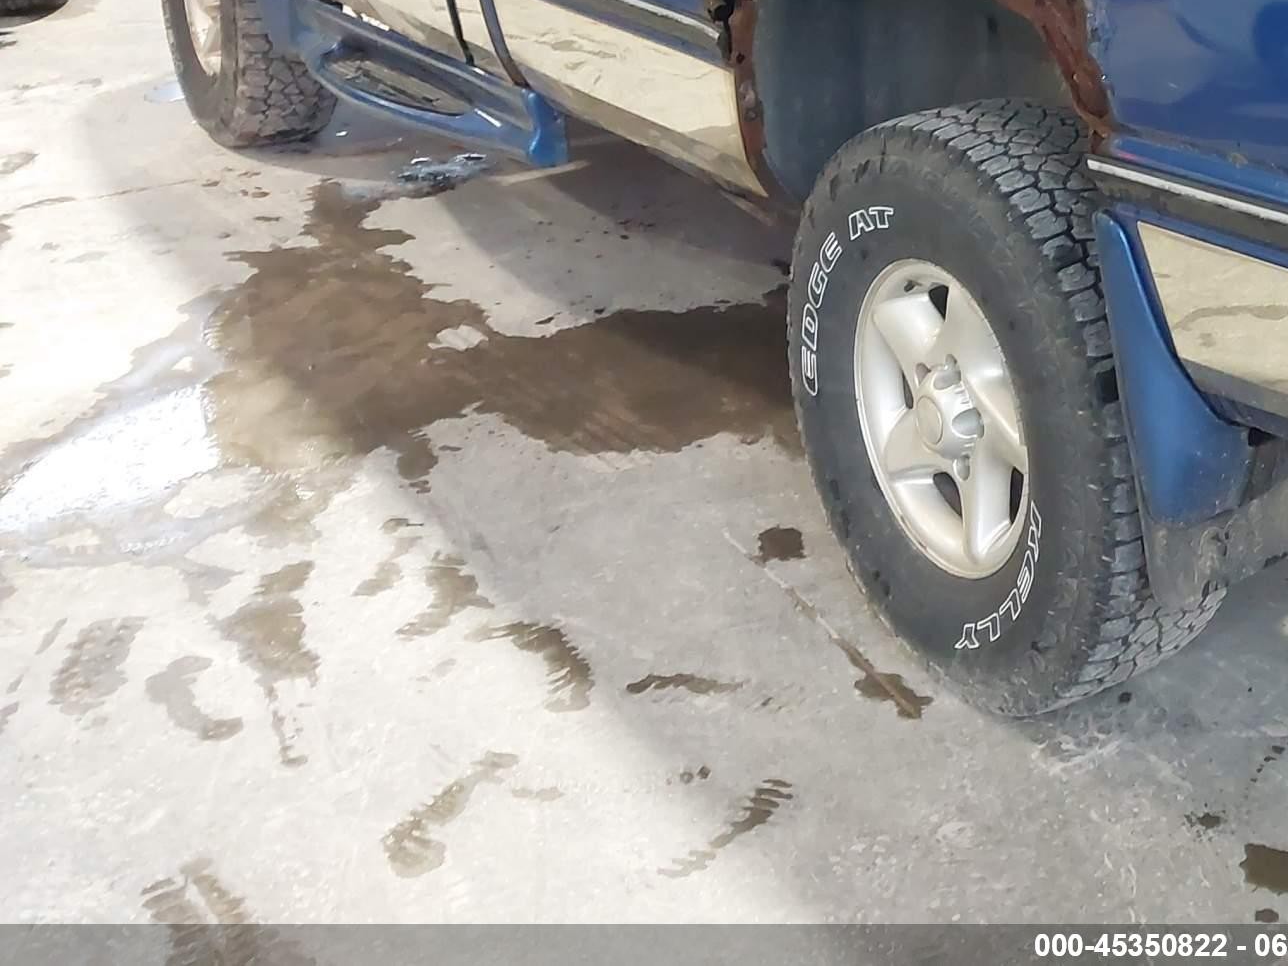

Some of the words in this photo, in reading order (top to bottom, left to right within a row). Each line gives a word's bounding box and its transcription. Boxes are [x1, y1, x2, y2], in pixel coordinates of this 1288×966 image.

[801, 231, 843, 397] EDGE
[848, 206, 894, 241] AT
[954, 500, 1042, 650] KELLY
